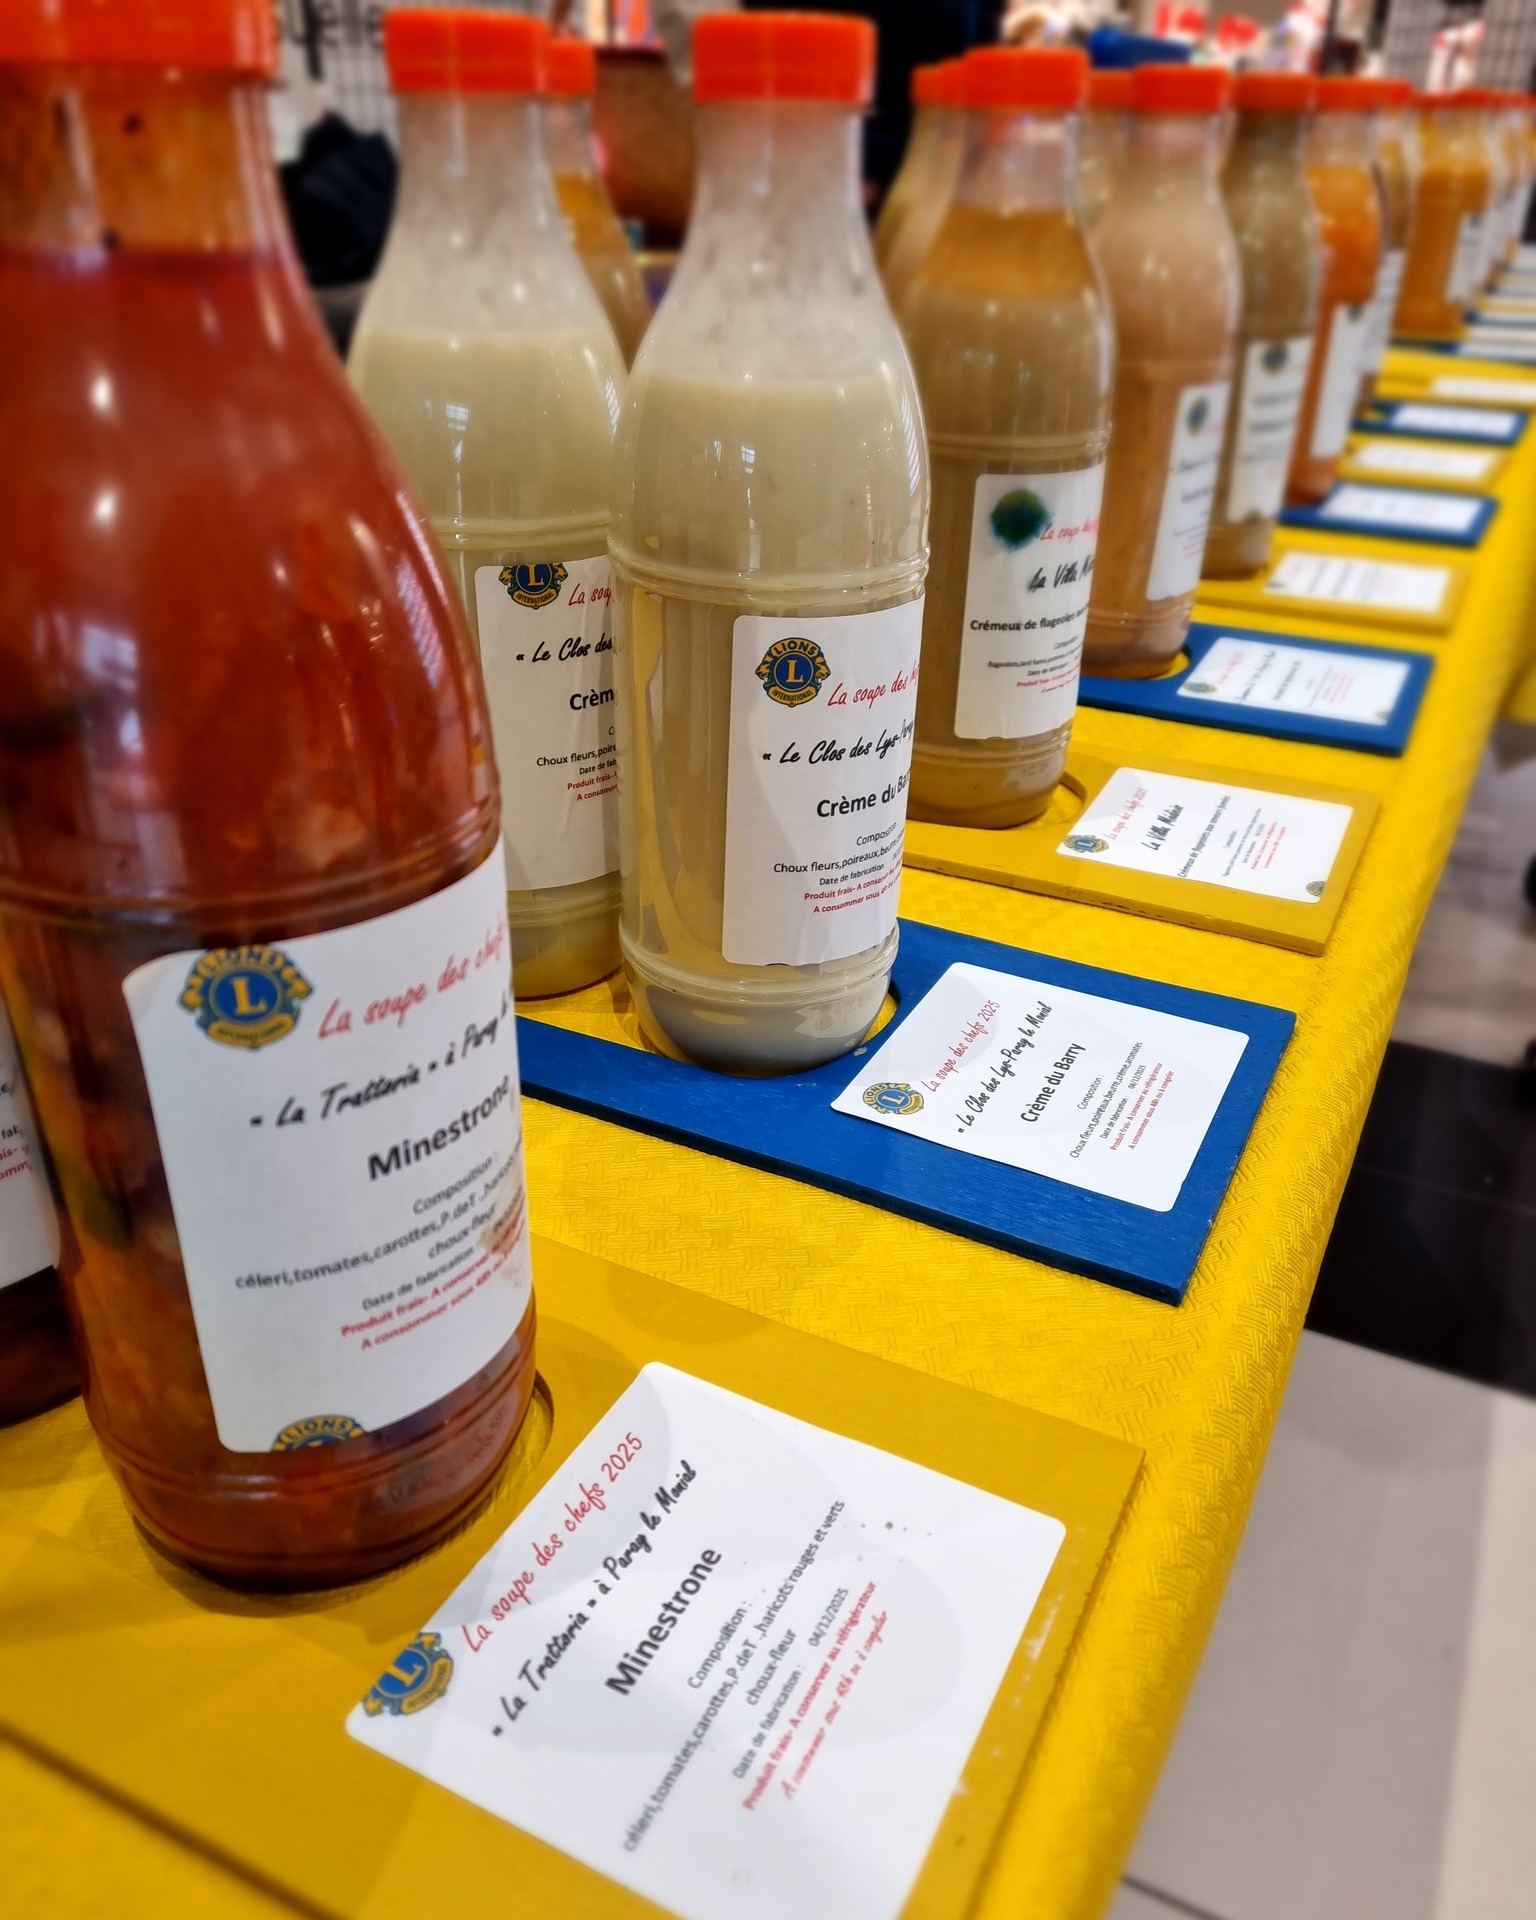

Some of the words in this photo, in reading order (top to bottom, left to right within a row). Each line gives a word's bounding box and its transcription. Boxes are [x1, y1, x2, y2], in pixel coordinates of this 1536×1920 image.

[1028, 566, 1047, 589] La
[568, 583, 586, 607] La
[1024, 619, 1038, 630] de
[531, 641, 552, 663] Le
[558, 636, 591, 662] Clos
[595, 632, 613, 652] des
[771, 639, 817, 657] LIONS
[786, 659, 804, 683] L
[569, 688, 615, 711] Crèm
[771, 689, 815, 702] INTERNATIONAL
[827, 681, 848, 707] La
[853, 683, 887, 709] soupe
[891, 670, 908, 694] des
[536, 755, 568, 767] Choux
[780, 741, 802, 764] Le
[808, 739, 844, 764] Clos
[849, 736, 873, 759] des
[579, 765, 596, 775] Date
[597, 761, 605, 770] de
[567, 778, 595, 790] Produit
[577, 793, 583, 801] A
[816, 791, 878, 818] Crème
[881, 783, 897, 804] du
[1145, 825, 1171, 841] Villa
[1141, 841, 1162, 851] La
[773, 863, 809, 873] Choux
[819, 876, 839, 886] Date
[840, 873, 849, 883] de
[850, 863, 885, 880] fabrication
[804, 890, 836, 901] Produit
[837, 886, 856, 897] frais-
[856, 882, 862, 891] A
[813, 905, 820, 913] A
[822, 896, 864, 912] consommer
[866, 891, 880, 902] sous
[231, 975, 269, 1016] L
[318, 998, 352, 1040] La
[363, 983, 428, 1029] soupe
[437, 953, 471, 993] des
[1025, 1000, 1053, 1029] Monial
[1018, 1027, 1035, 1038] le
[921, 1079, 941, 1092] La
[935, 1058, 960, 1080] soupe
[948, 1042, 969, 1058] des
[961, 1021, 989, 1043] chefs
[977, 1000, 1000, 1022] 2025
[1053, 1042, 1087, 1071] Barry
[990, 1037, 1035, 1079] Lys-Paray
[980, 1076, 1001, 1094] des
[1044, 1069, 1066, 1086] du
[1161, 1071, 1175, 1089] congeler
[275, 1094, 307, 1130] La
[321, 1063, 420, 1120] Trattoria
[865, 1083, 888, 1103] LIONS
[881, 1095, 905, 1105] L
[964, 1091, 991, 1113] Clos
[1020, 1086, 1056, 1123] Crème
[1077, 1077, 1102, 1110] Composition
[1149, 1098, 1160, 1107] 48h
[1109, 1098, 1129, 1121] fabrication
[1110, 1132, 1125, 1151] Produit
[1119, 1120, 1131, 1133] frais-
[1130, 1095, 1145, 1117] conserver
[1144, 1062, 1163, 1089] réfrigérateur
[1145, 1107, 1156, 1118] sous
[367, 1075, 510, 1181] Minestrone
[955, 1113, 975, 1127] Le
[1107, 1121, 1116, 1129] de
[1132, 1118, 1150, 1145] consommer
[1100, 1127, 1112, 1139] Date
[1069, 1139, 1087, 1159] Choux
[412, 1155, 493, 1216] Composition
[428, 1203, 497, 1260] choux-fleur
[361, 1291, 395, 1312] Date
[397, 1280, 414, 1298] de
[340, 1310, 393, 1337] Produit
[431, 1286, 442, 1299] A
[360, 1337, 372, 1350] A
[462, 1622, 492, 1653] La
[491, 1570, 535, 1622] soupe
[532, 1533, 563, 1567] des
[564, 1481, 607, 1533] chefs
[600, 1432, 643, 1483] 2025
[788, 1542, 820, 1583] rouges
[813, 1527, 829, 1542] et
[821, 1500, 846, 1530] verts
[500, 1695, 528, 1722] La
[518, 1609, 590, 1692] Trattoria
[592, 1579, 612, 1596] à
[603, 1533, 653, 1581] Paray
[639, 1511, 662, 1531] le
[654, 1459, 698, 1515] Monial
[604, 1548, 723, 1697] Minestrone
[687, 1606, 748, 1689] Composition
[745, 1628, 798, 1706] choux-fleur
[731, 1749, 757, 1779] Date
[752, 1731, 768, 1748] de
[760, 1669, 802, 1731] fabrication
[807, 1587, 849, 1648] 04/12/2025
[742, 1761, 777, 1811] Produit
[788, 1717, 802, 1729] A
[796, 1661, 832, 1718] conserver
[827, 1646, 842, 1662] au
[836, 1581, 877, 1646] réfrigérateur
